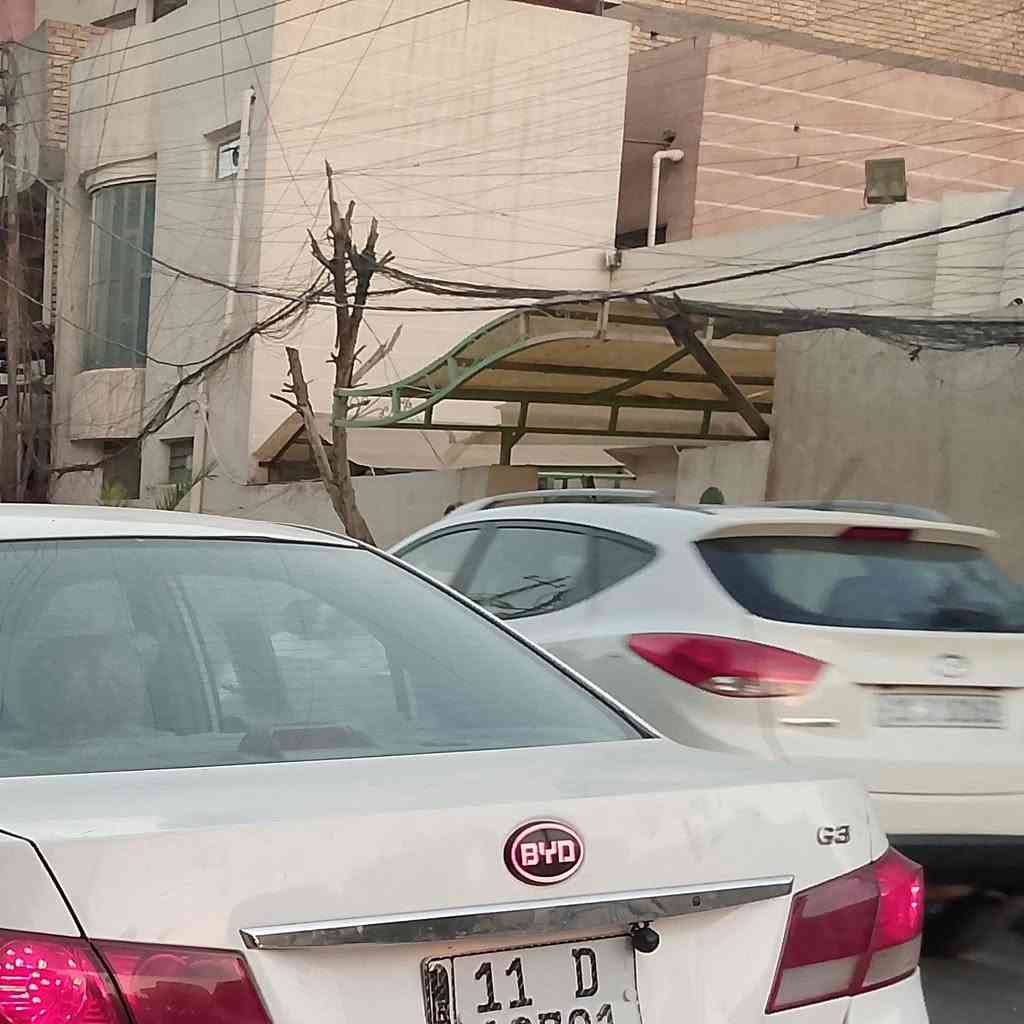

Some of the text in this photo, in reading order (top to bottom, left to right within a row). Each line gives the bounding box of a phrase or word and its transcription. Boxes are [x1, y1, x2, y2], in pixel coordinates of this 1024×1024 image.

[817, 825, 850, 845] G3
[520, 839, 576, 866] BYD
[475, 947, 599, 1013] 11 D
